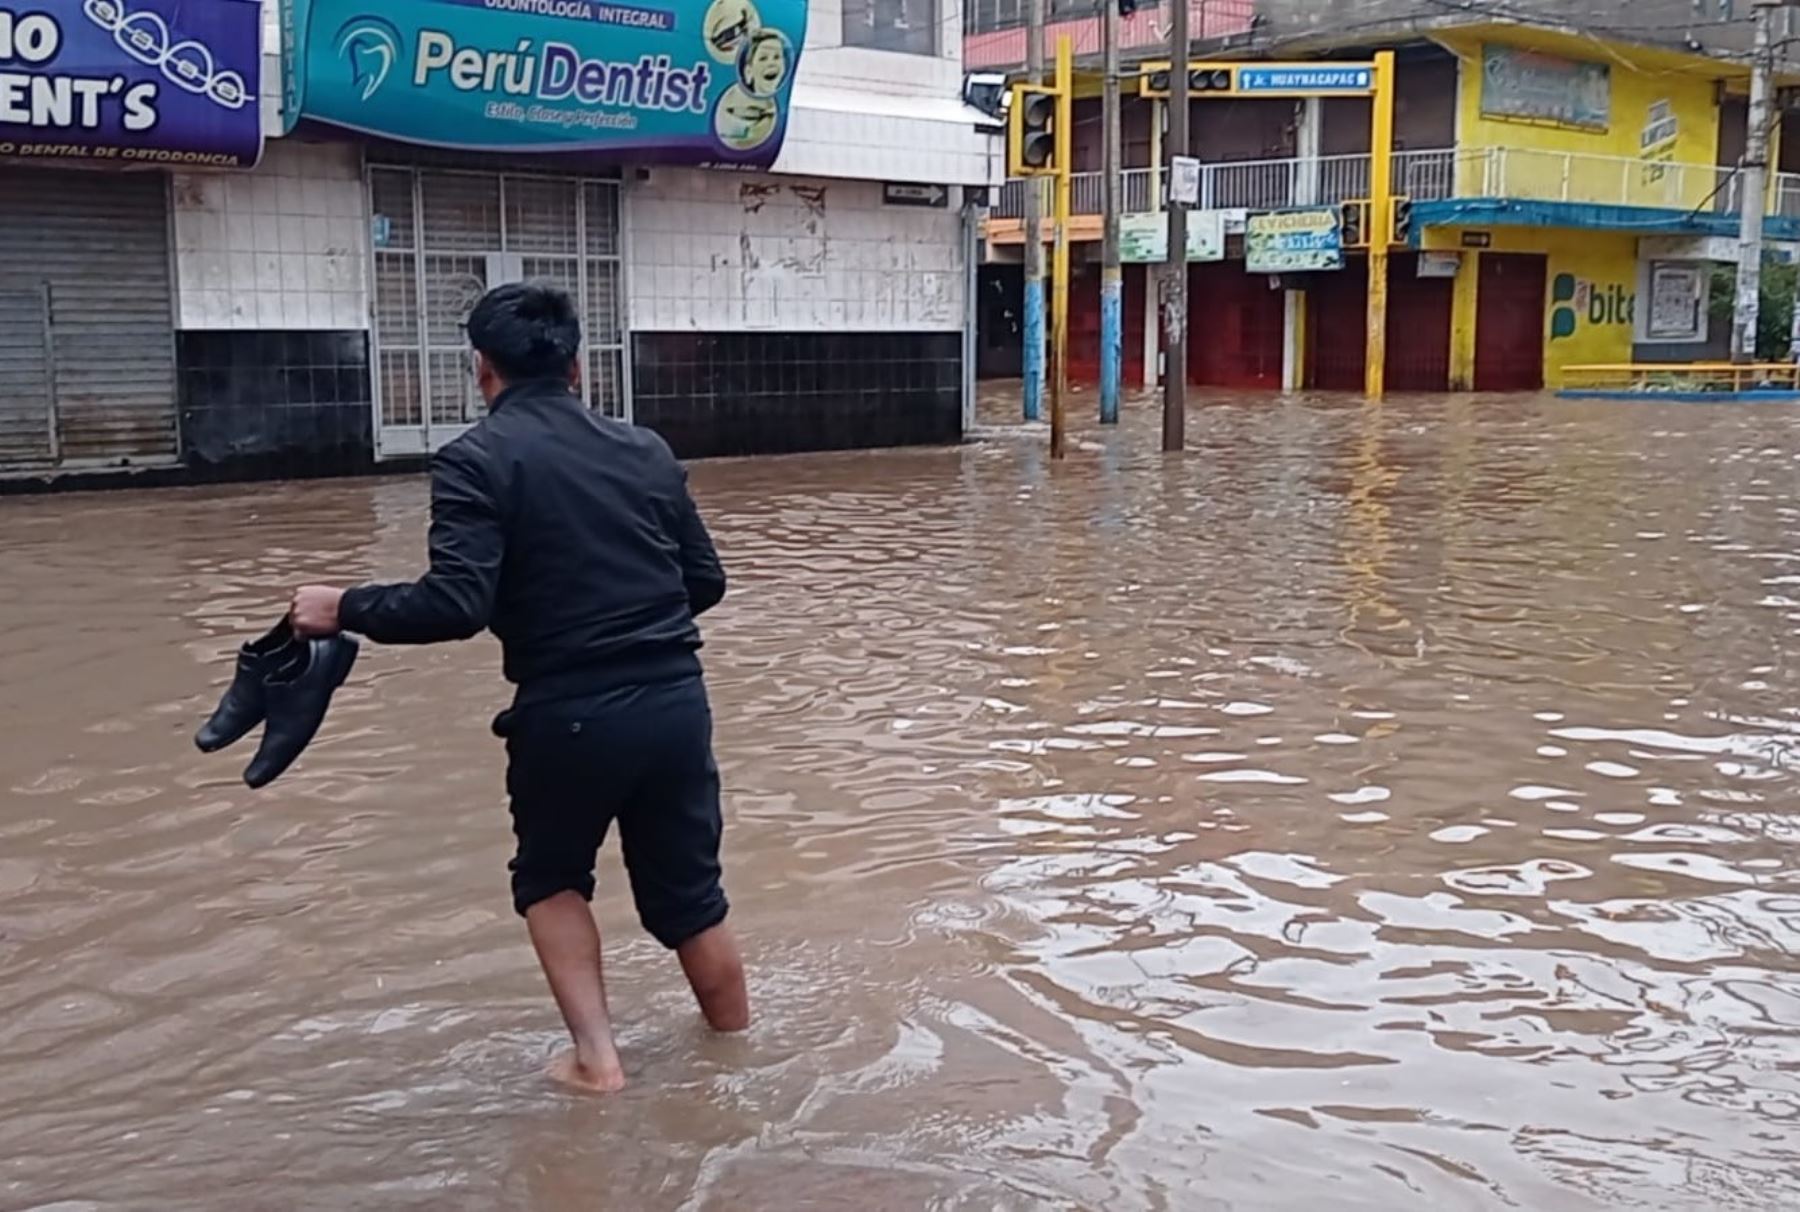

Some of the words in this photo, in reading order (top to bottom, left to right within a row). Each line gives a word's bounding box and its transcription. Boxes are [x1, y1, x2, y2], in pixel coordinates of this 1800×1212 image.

[485, 0, 592, 19] ODONTOLOGÍA
[598, 8, 667, 28] INTEGRAL
[0, 73, 157, 130] ENT'S
[19, 144, 89, 157] DENTAL
[93, 147, 120, 158] DE
[121, 148, 239, 166] ORTODONCIA
